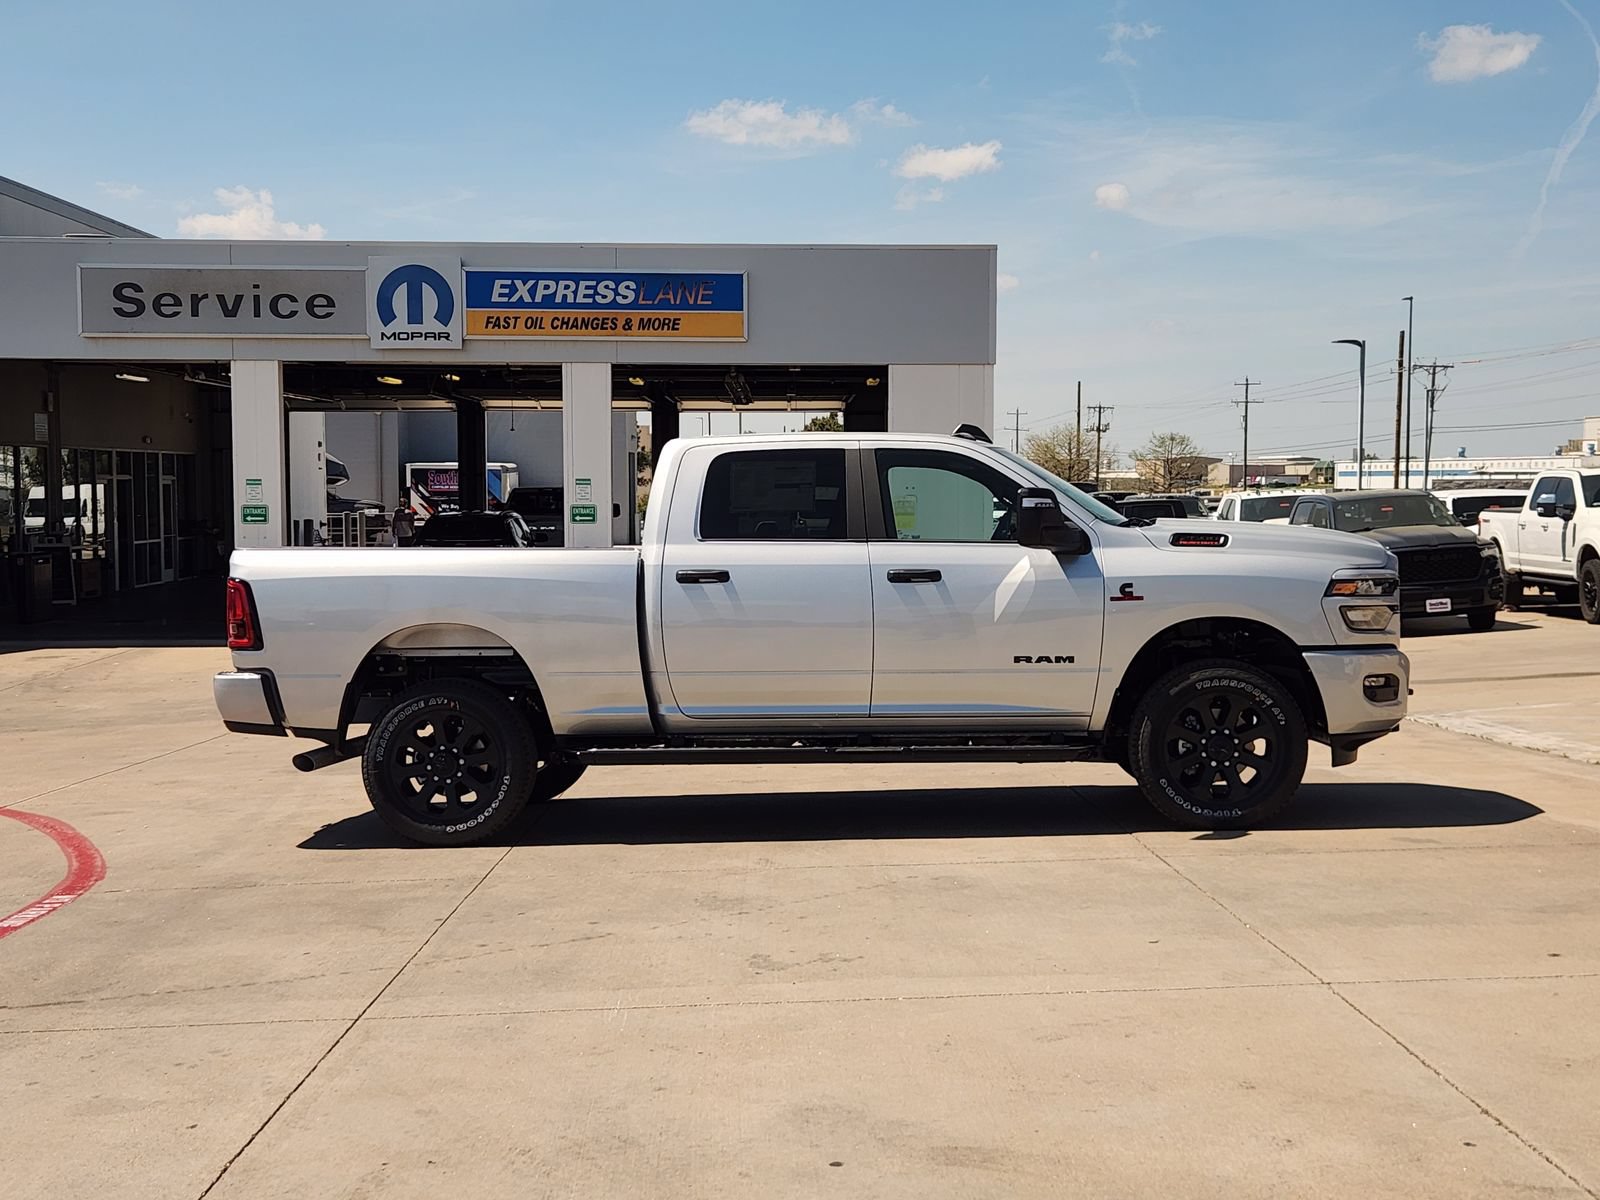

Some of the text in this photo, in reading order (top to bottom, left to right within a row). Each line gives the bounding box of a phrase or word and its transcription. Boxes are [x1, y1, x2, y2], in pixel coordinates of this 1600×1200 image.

[112, 281, 337, 320] Service
[484, 315, 681, 331] FAST OIL CHANGES & MORE
[380, 331, 452, 342] MOPAR
[243, 507, 266, 515] ENTRANCE
[572, 507, 595, 515] ENTRANCE
[1013, 655, 1075, 664] RAM
[1195, 678, 1274, 707] TRANSFORCE
[375, 699, 426, 763] TRANSFORCE
